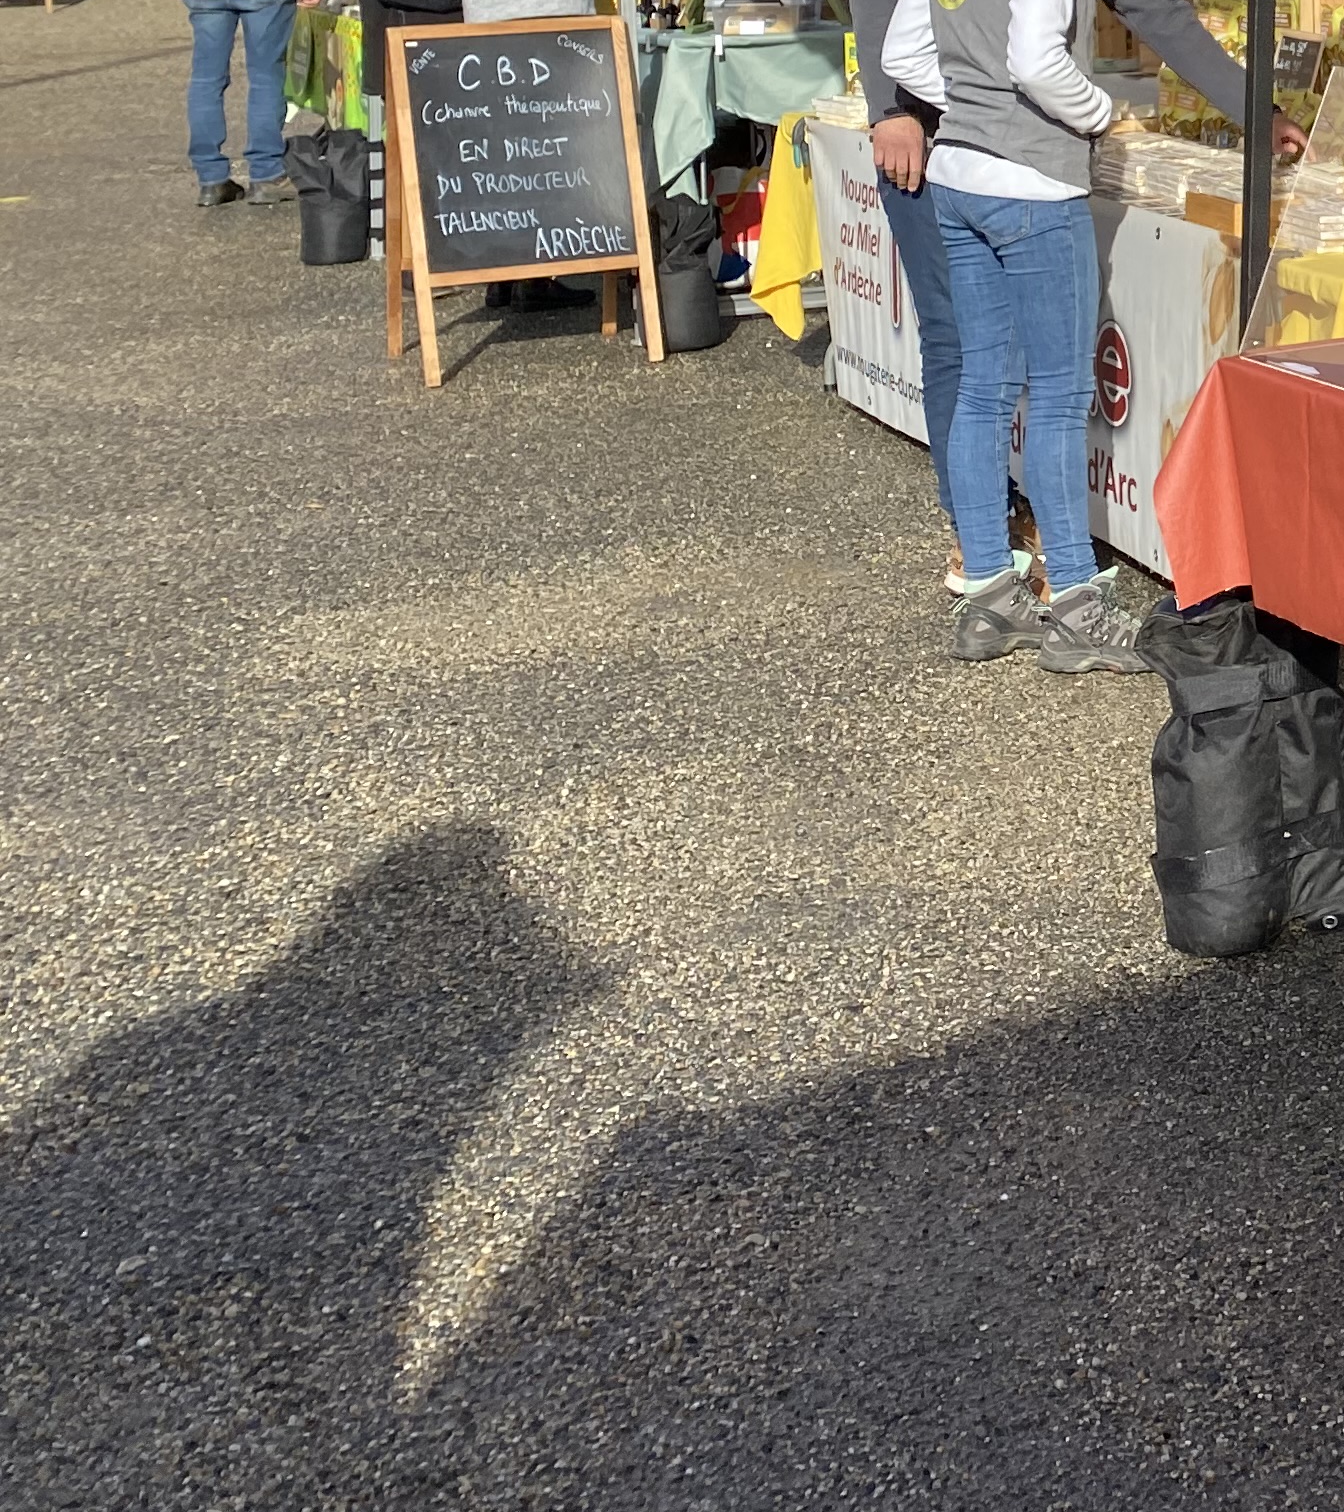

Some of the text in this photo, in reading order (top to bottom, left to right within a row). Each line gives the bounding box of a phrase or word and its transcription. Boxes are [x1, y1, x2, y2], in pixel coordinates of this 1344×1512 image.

[459, 138, 489, 163] EN
[436, 166, 592, 200] DU PRODUCTEUR
[840, 223, 881, 259] au Miel
[833, 256, 884, 308] d'Ardèche
